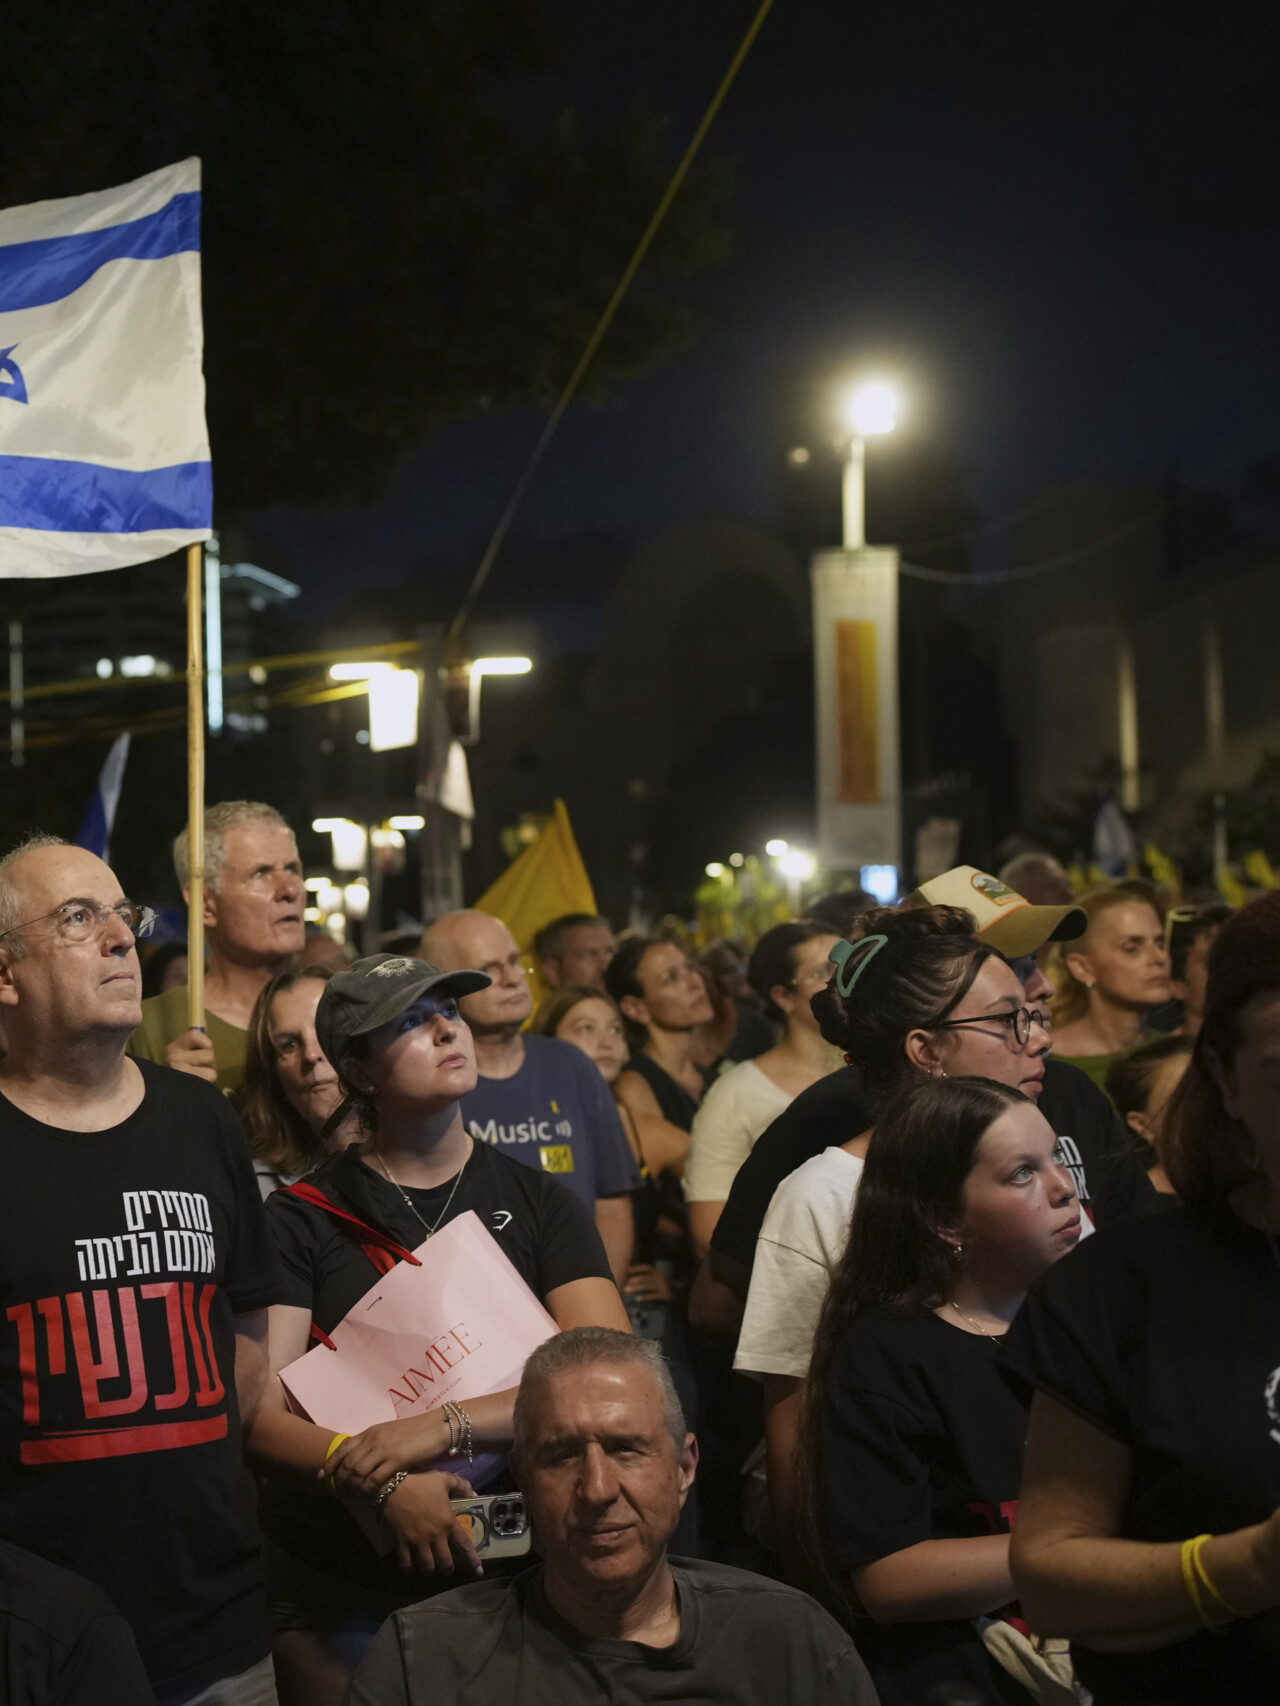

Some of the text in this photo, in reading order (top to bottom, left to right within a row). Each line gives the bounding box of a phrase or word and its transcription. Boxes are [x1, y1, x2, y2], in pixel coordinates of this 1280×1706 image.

[469, 1116, 552, 1144] Music
[122, 1190, 213, 1233] מחזירים
[74, 1230, 216, 1281] אותם הביתה
[5, 1281, 225, 1427] עכשיו
